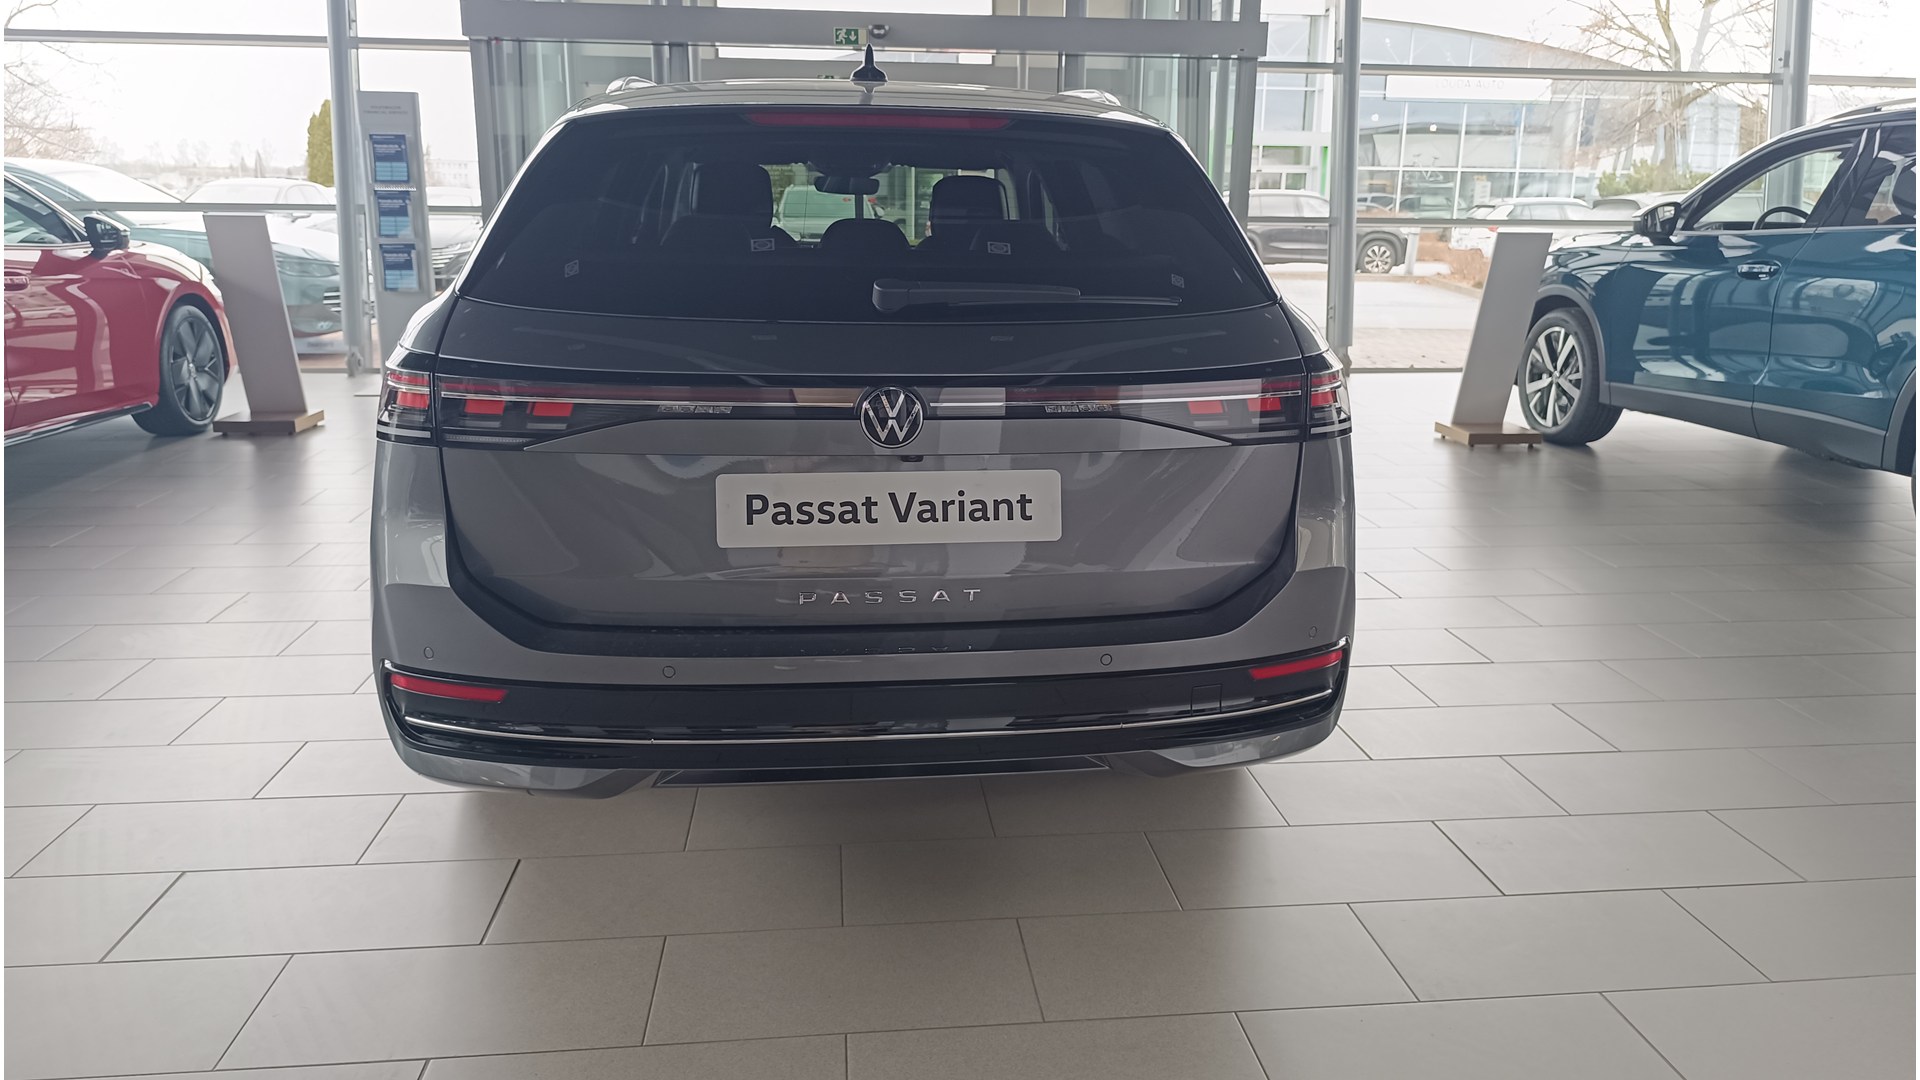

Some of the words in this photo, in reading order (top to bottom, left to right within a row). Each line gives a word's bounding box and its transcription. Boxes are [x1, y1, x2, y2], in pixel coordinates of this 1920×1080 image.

[746, 494, 878, 525] Passat
[888, 490, 1033, 523] Variant
[798, 588, 981, 605] PASSAT
